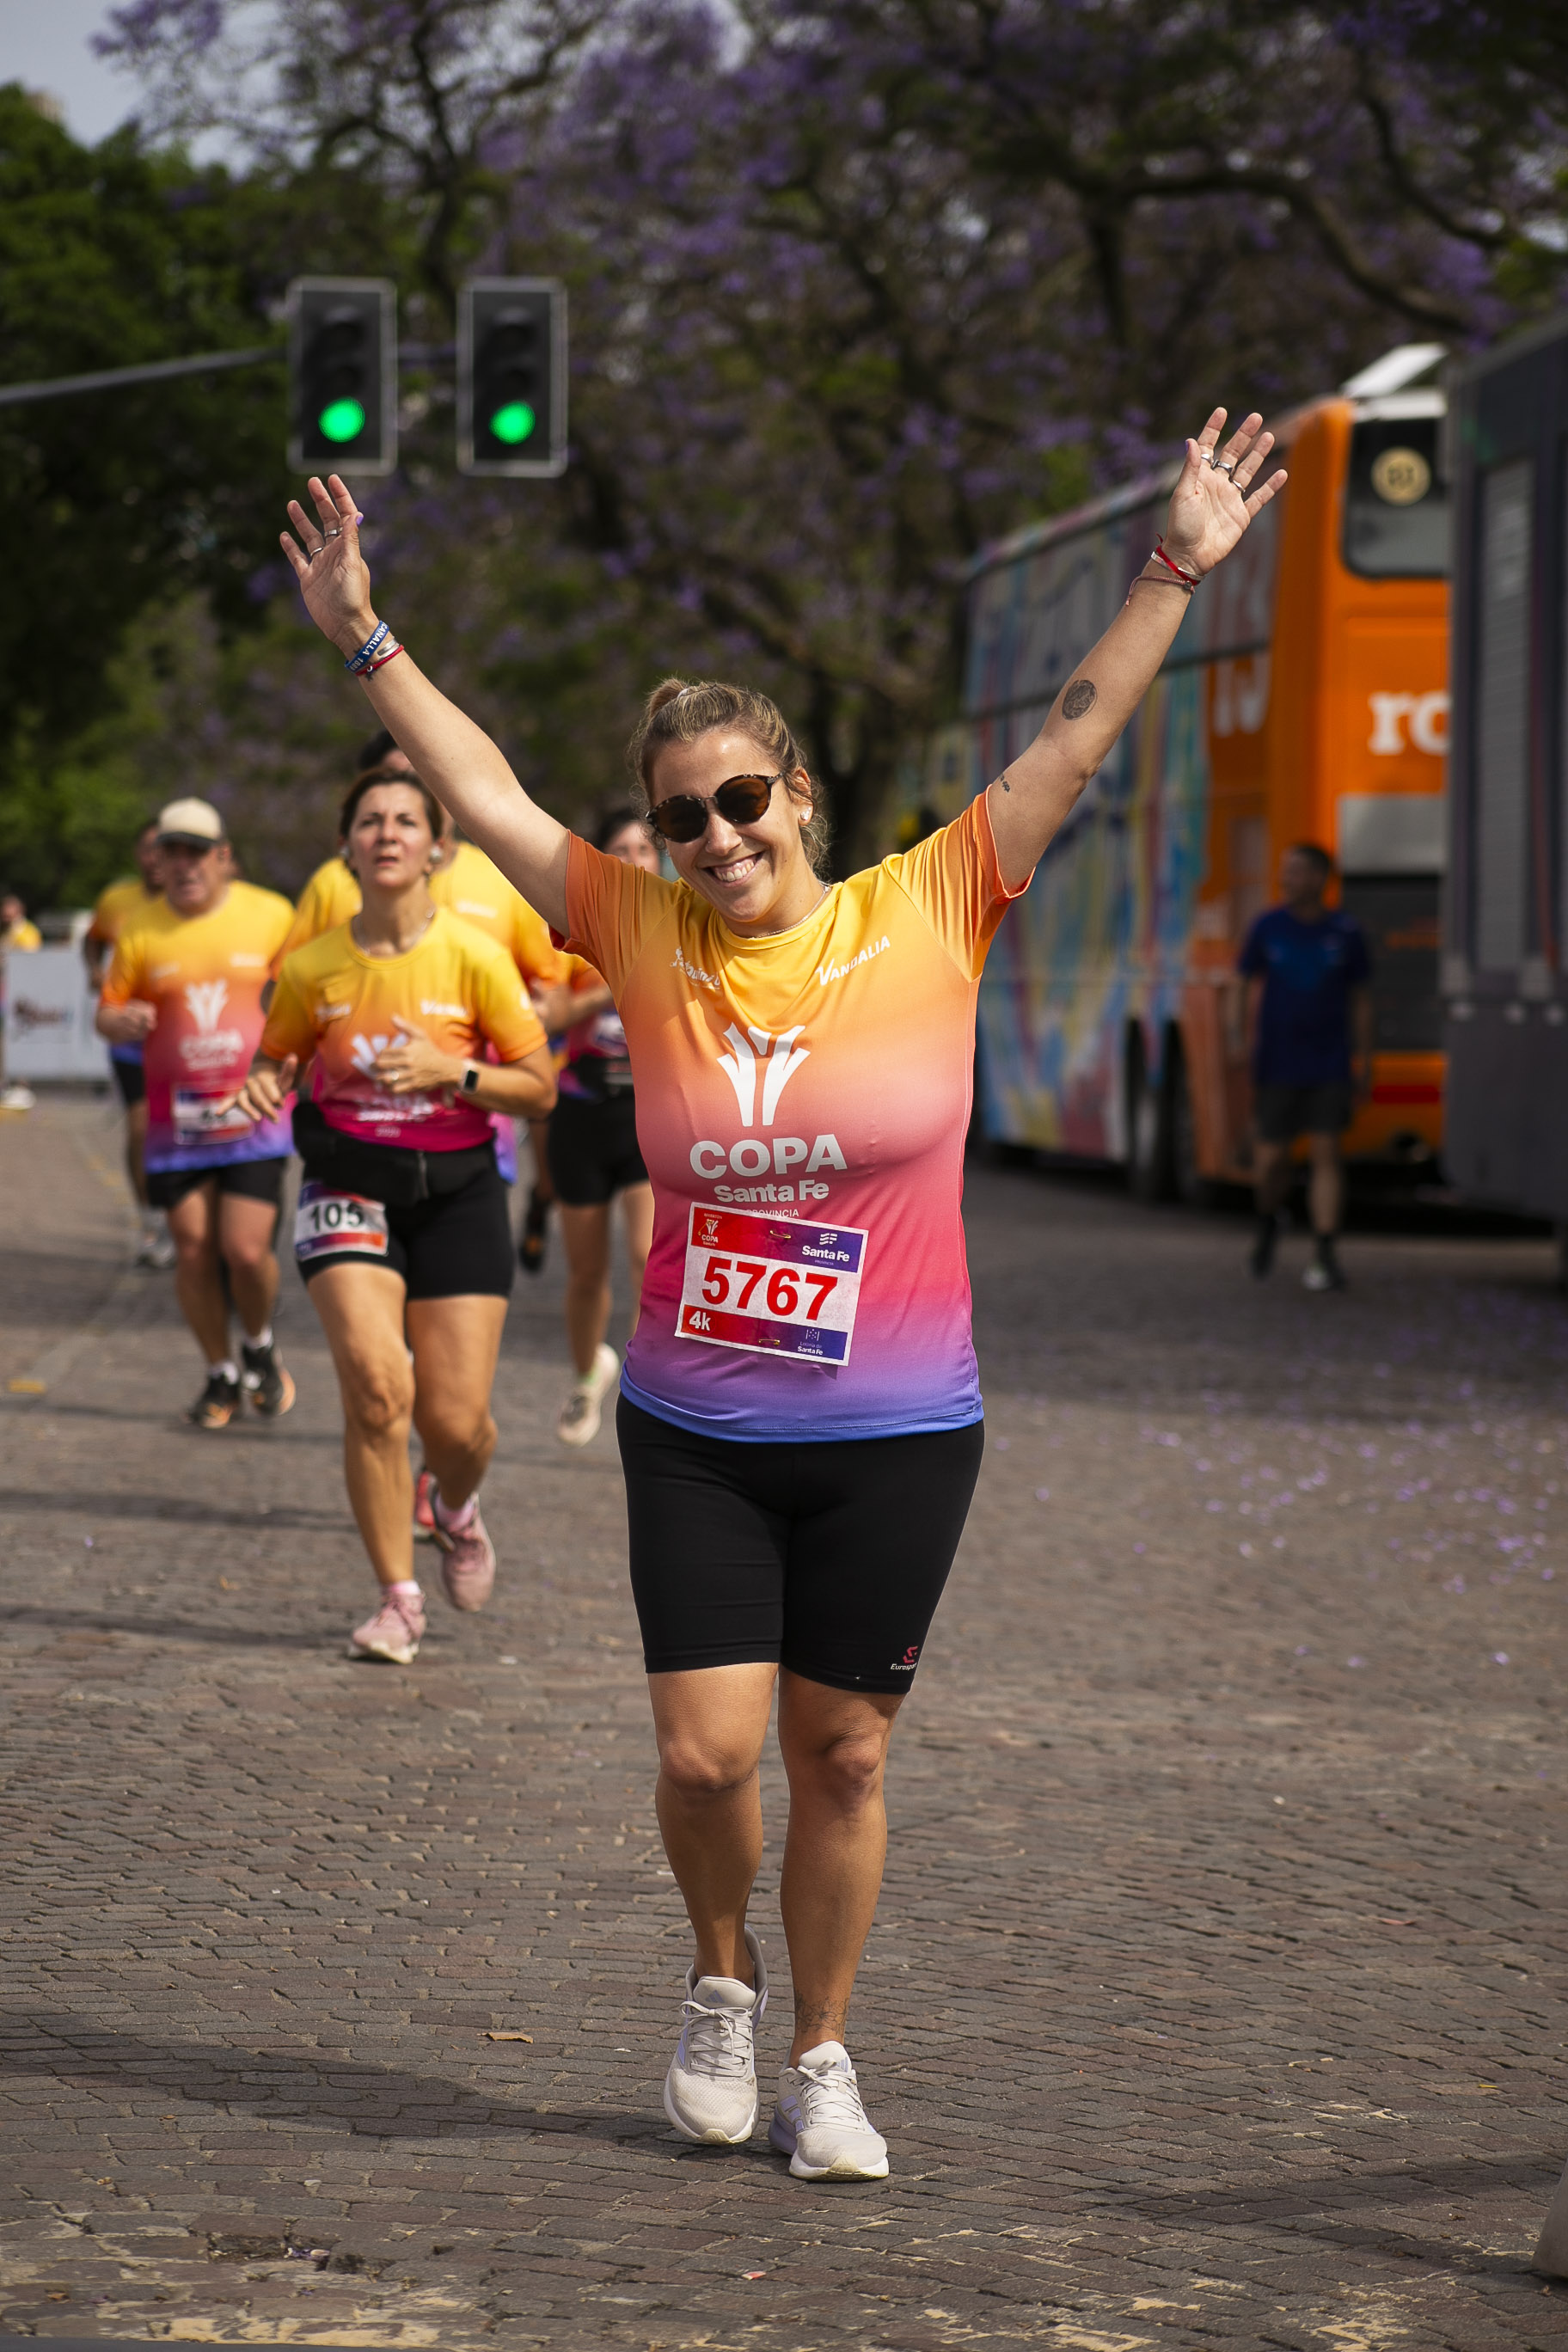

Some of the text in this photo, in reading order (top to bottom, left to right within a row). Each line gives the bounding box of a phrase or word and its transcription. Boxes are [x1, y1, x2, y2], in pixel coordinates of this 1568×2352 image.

[814, 935, 891, 986] VANDALIA
[689, 1133, 848, 1179] COPA
[714, 1179, 830, 1203] Santa Fe
[746, 1209, 799, 1217] OVINCIA
[701, 1234, 719, 1243] COPA
[801, 1245, 849, 1262] Santa Fe
[701, 1256, 838, 1321] 5767
[689, 1310, 712, 1332] 4k
[797, 1345, 816, 1355] Santa
